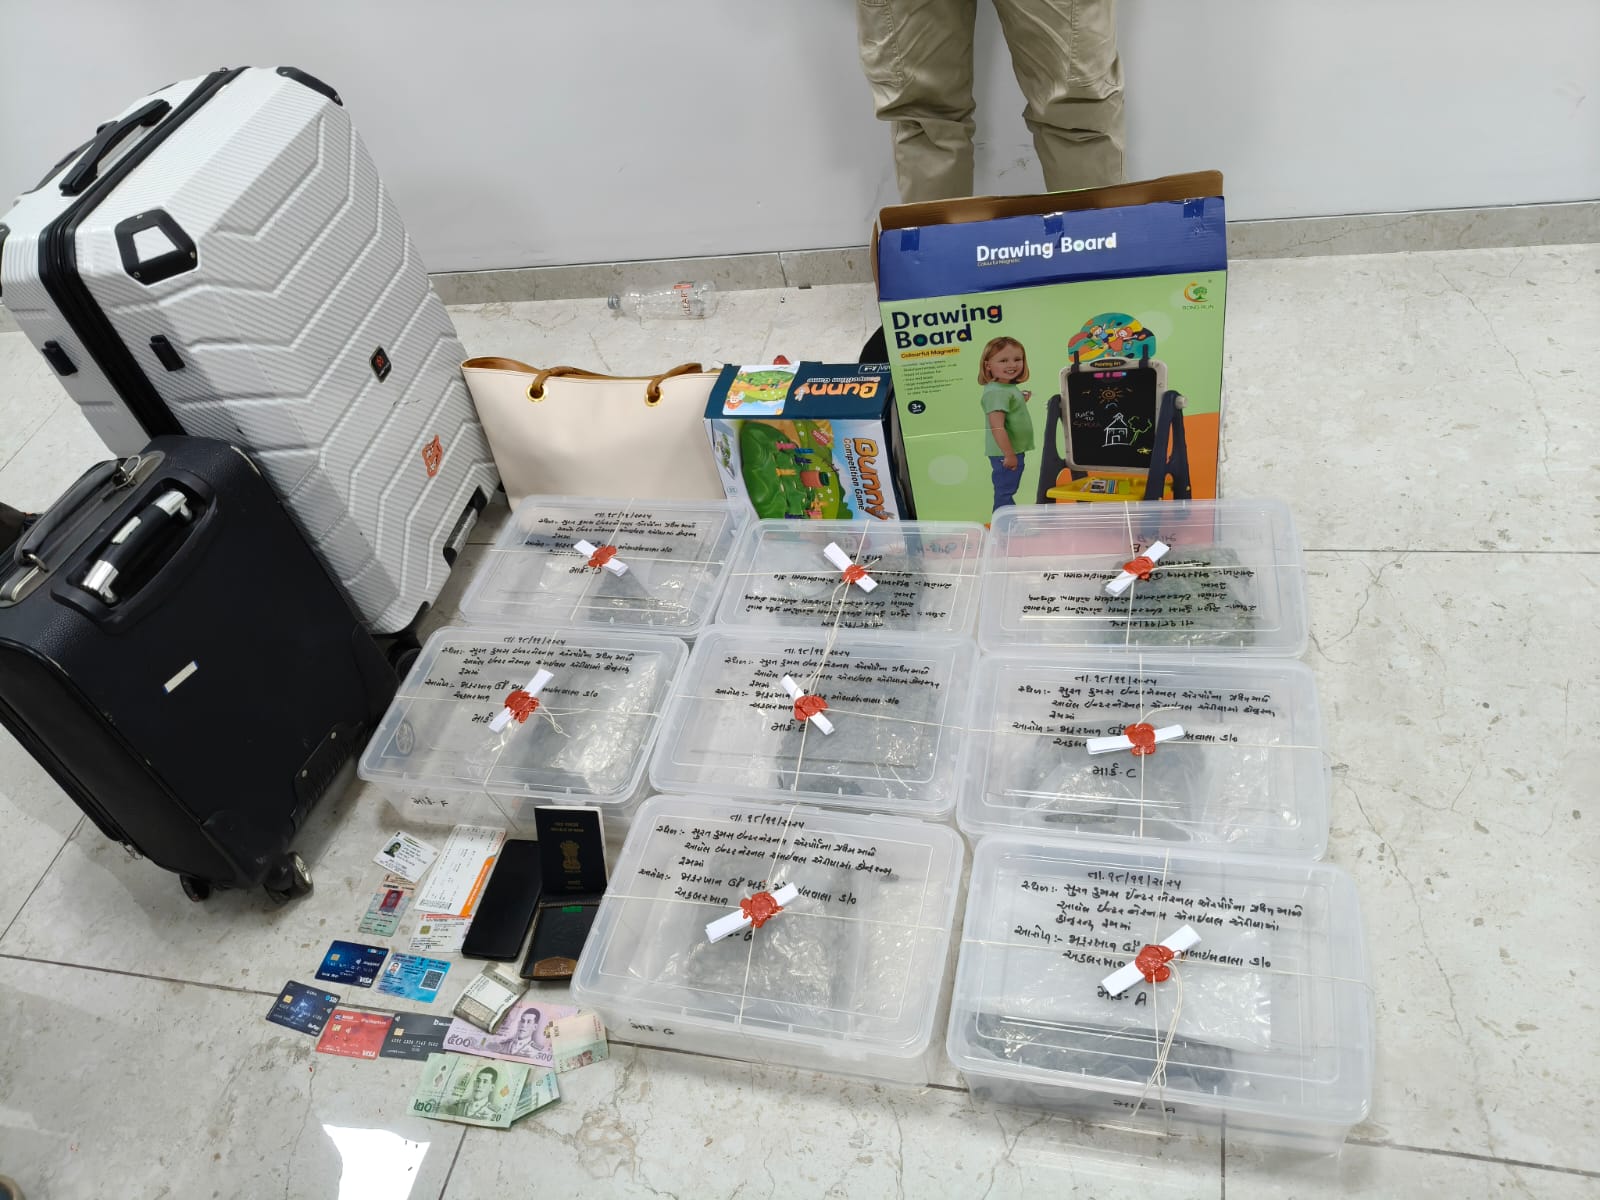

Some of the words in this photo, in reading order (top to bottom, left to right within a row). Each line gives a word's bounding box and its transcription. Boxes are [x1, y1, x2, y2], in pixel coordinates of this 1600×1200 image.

[976, 239, 1053, 262] Drawing
[1060, 232, 1117, 253] Board
[892, 303, 1003, 330] Drawing
[895, 323, 972, 349] Board
[794, 382, 879, 400] Bunny
[843, 438, 859, 487] Competition
[854, 488, 864, 511] Game
[853, 438, 889, 520] Bunny
[1134, 991, 1147, 1006] A
[536, 1053, 552, 1062] 500
[490, 1113, 502, 1122] 20
